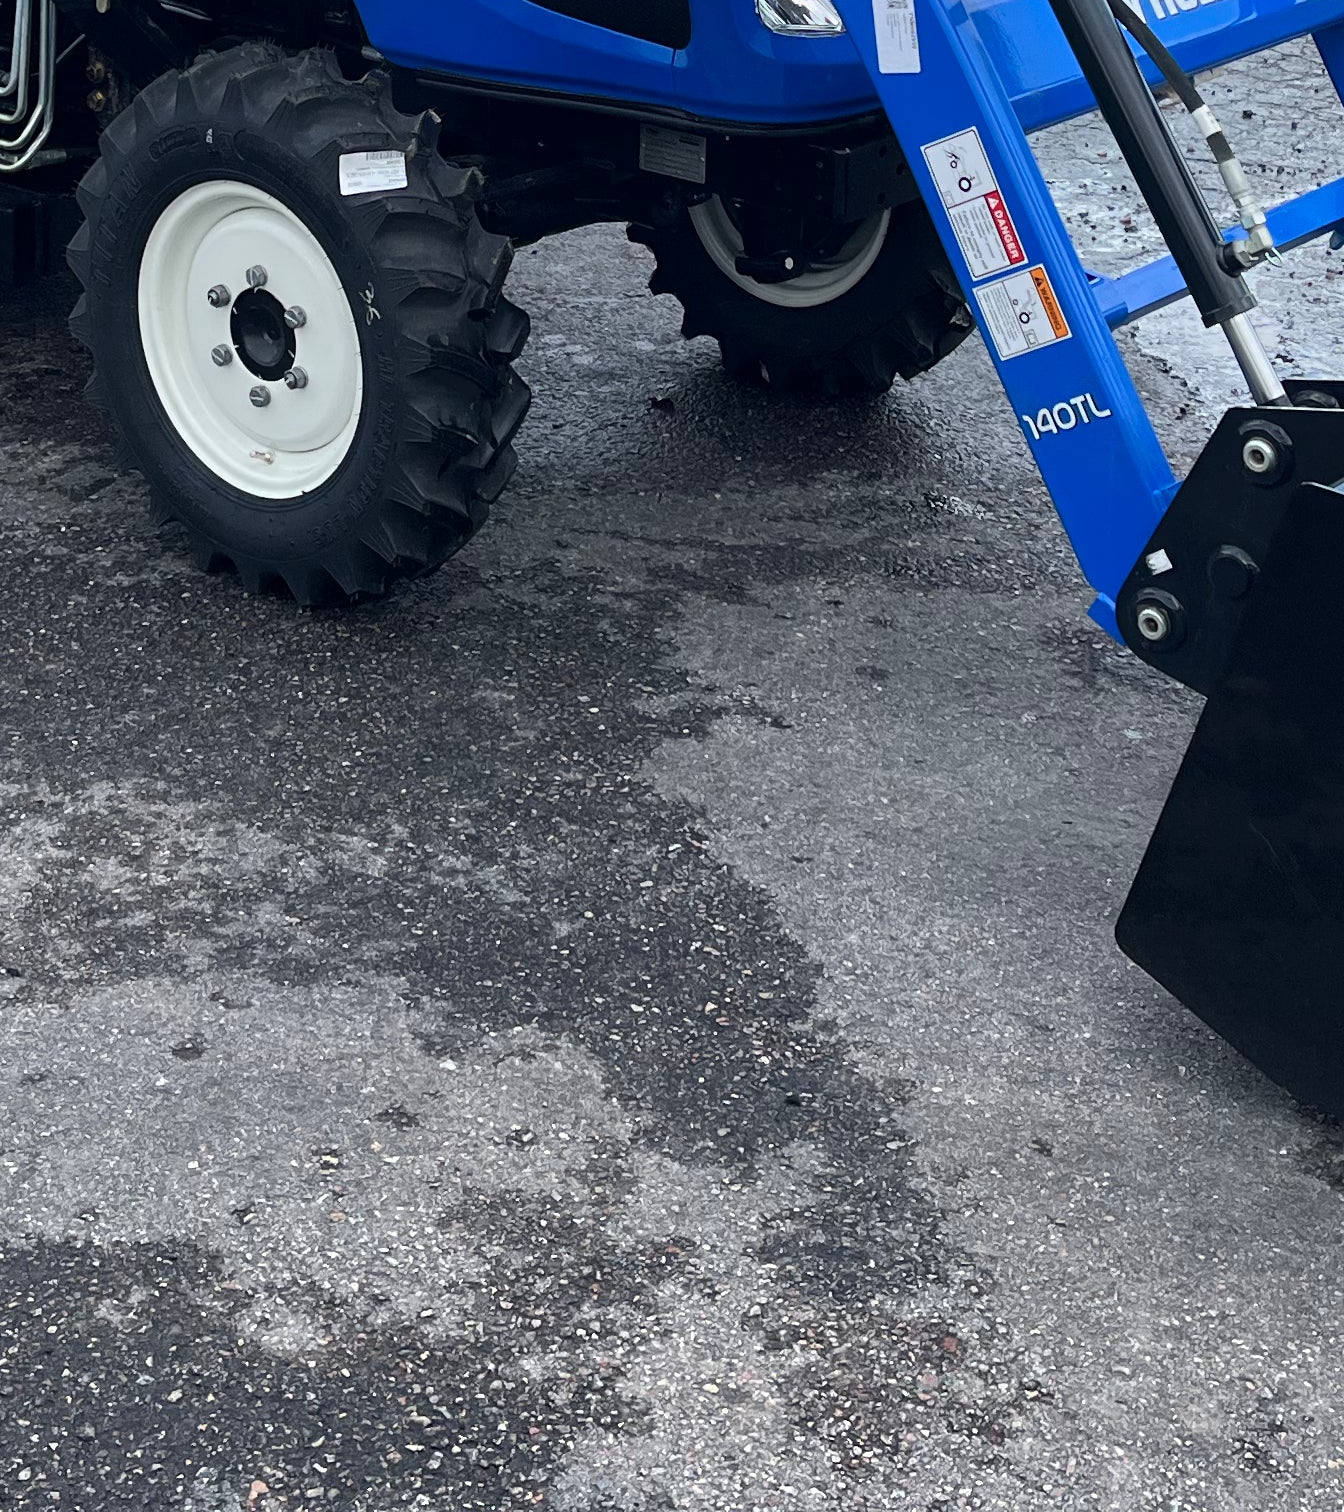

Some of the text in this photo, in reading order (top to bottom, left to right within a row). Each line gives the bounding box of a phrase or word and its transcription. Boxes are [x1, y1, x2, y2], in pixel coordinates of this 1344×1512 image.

[994, 209, 1019, 260] DANGER
[1040, 287, 1061, 331] WARNING
[1022, 393, 1112, 440] 140TL
